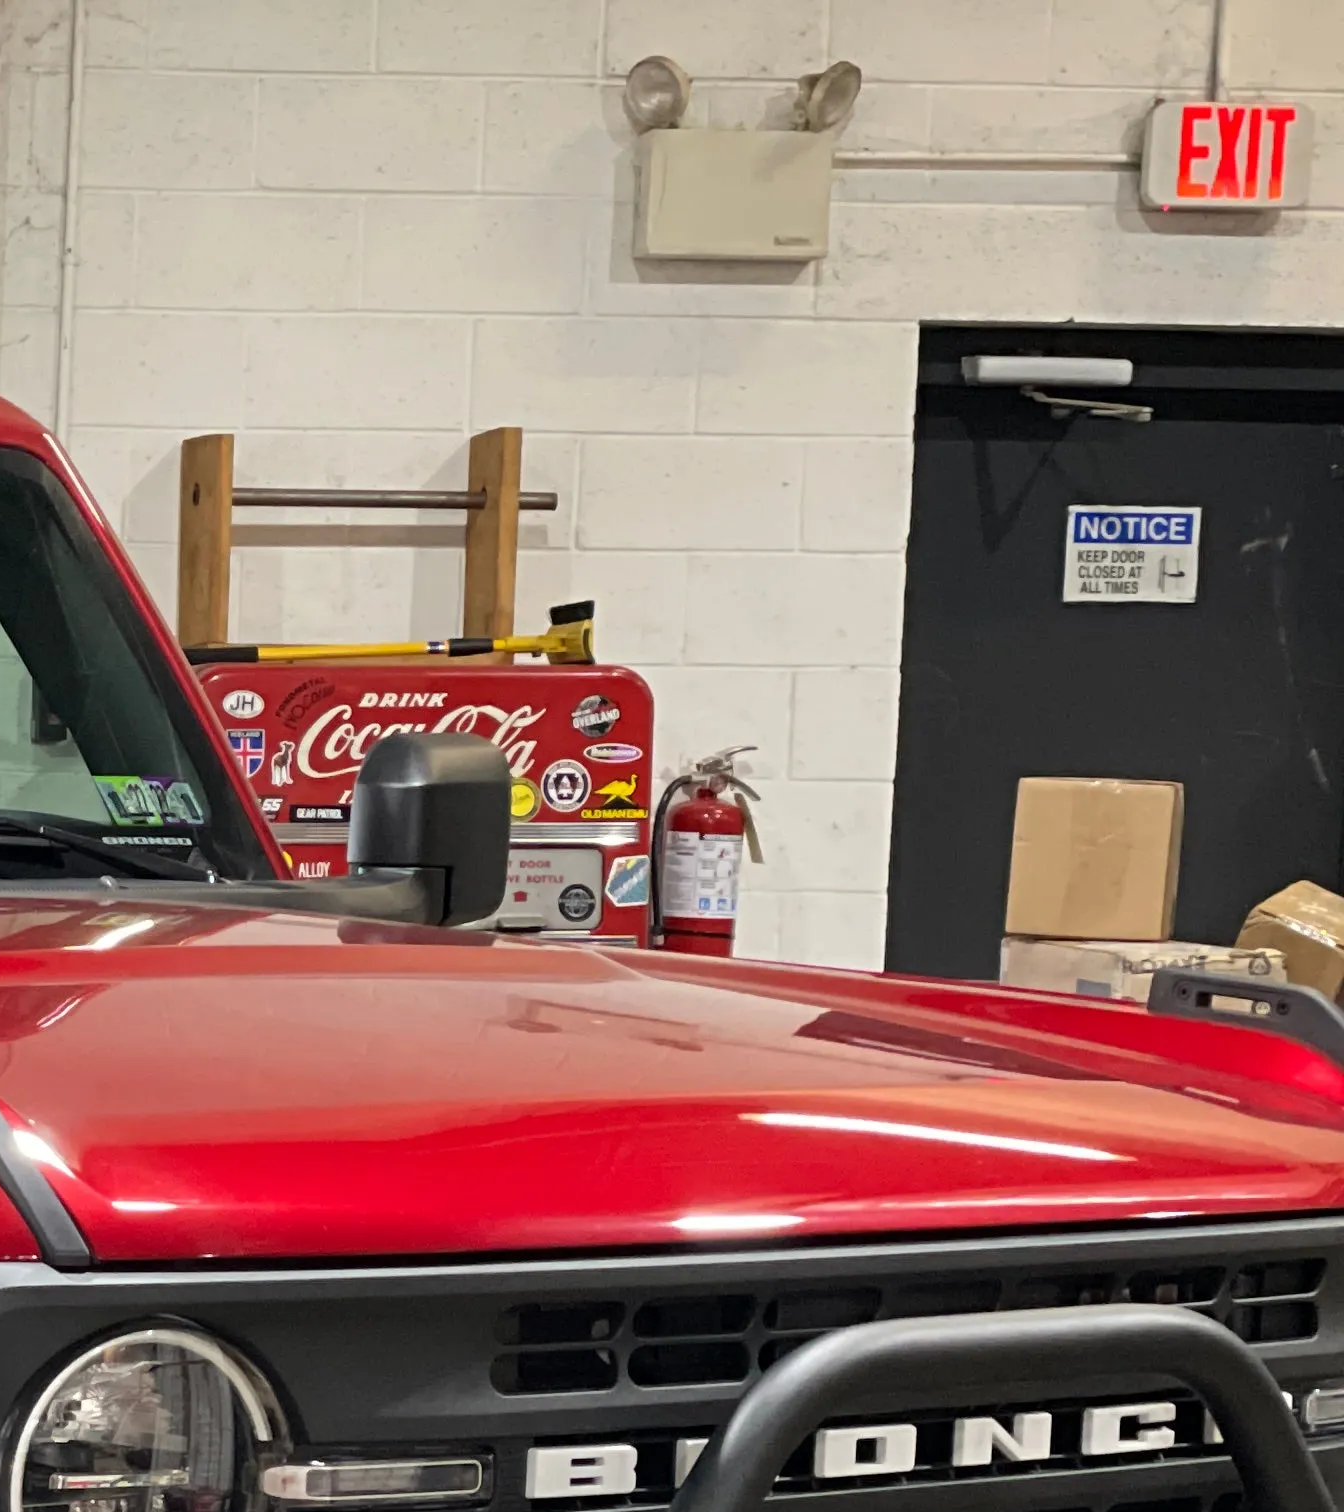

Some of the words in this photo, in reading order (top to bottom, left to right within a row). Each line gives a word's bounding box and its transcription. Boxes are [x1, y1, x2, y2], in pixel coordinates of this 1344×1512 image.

[1176, 104, 1297, 200] EXIT
[1079, 516, 1188, 541] NOTICE
[1077, 550, 1109, 563] KEEP
[1111, 551, 1145, 564] DOOR
[1078, 566, 1125, 579] CLOSED
[1128, 566, 1144, 578] AT
[1080, 581, 1102, 593] ALL
[1104, 582, 1139, 594] TIMES
[229, 694, 255, 712] JH
[358, 692, 449, 708] DRINK
[572, 708, 620, 729] OVERLAND
[296, 704, 547, 779] Coc-Cla
[580, 809, 601, 819] OLD
[602, 809, 625, 819] MAN
[626, 809, 649, 819] EMU
[298, 861, 331, 878] ALLOY
[519, 860, 551, 869] DOOR
[526, 875, 564, 884] BOTTLE
[525, 1390, 1293, 1500] BONC
